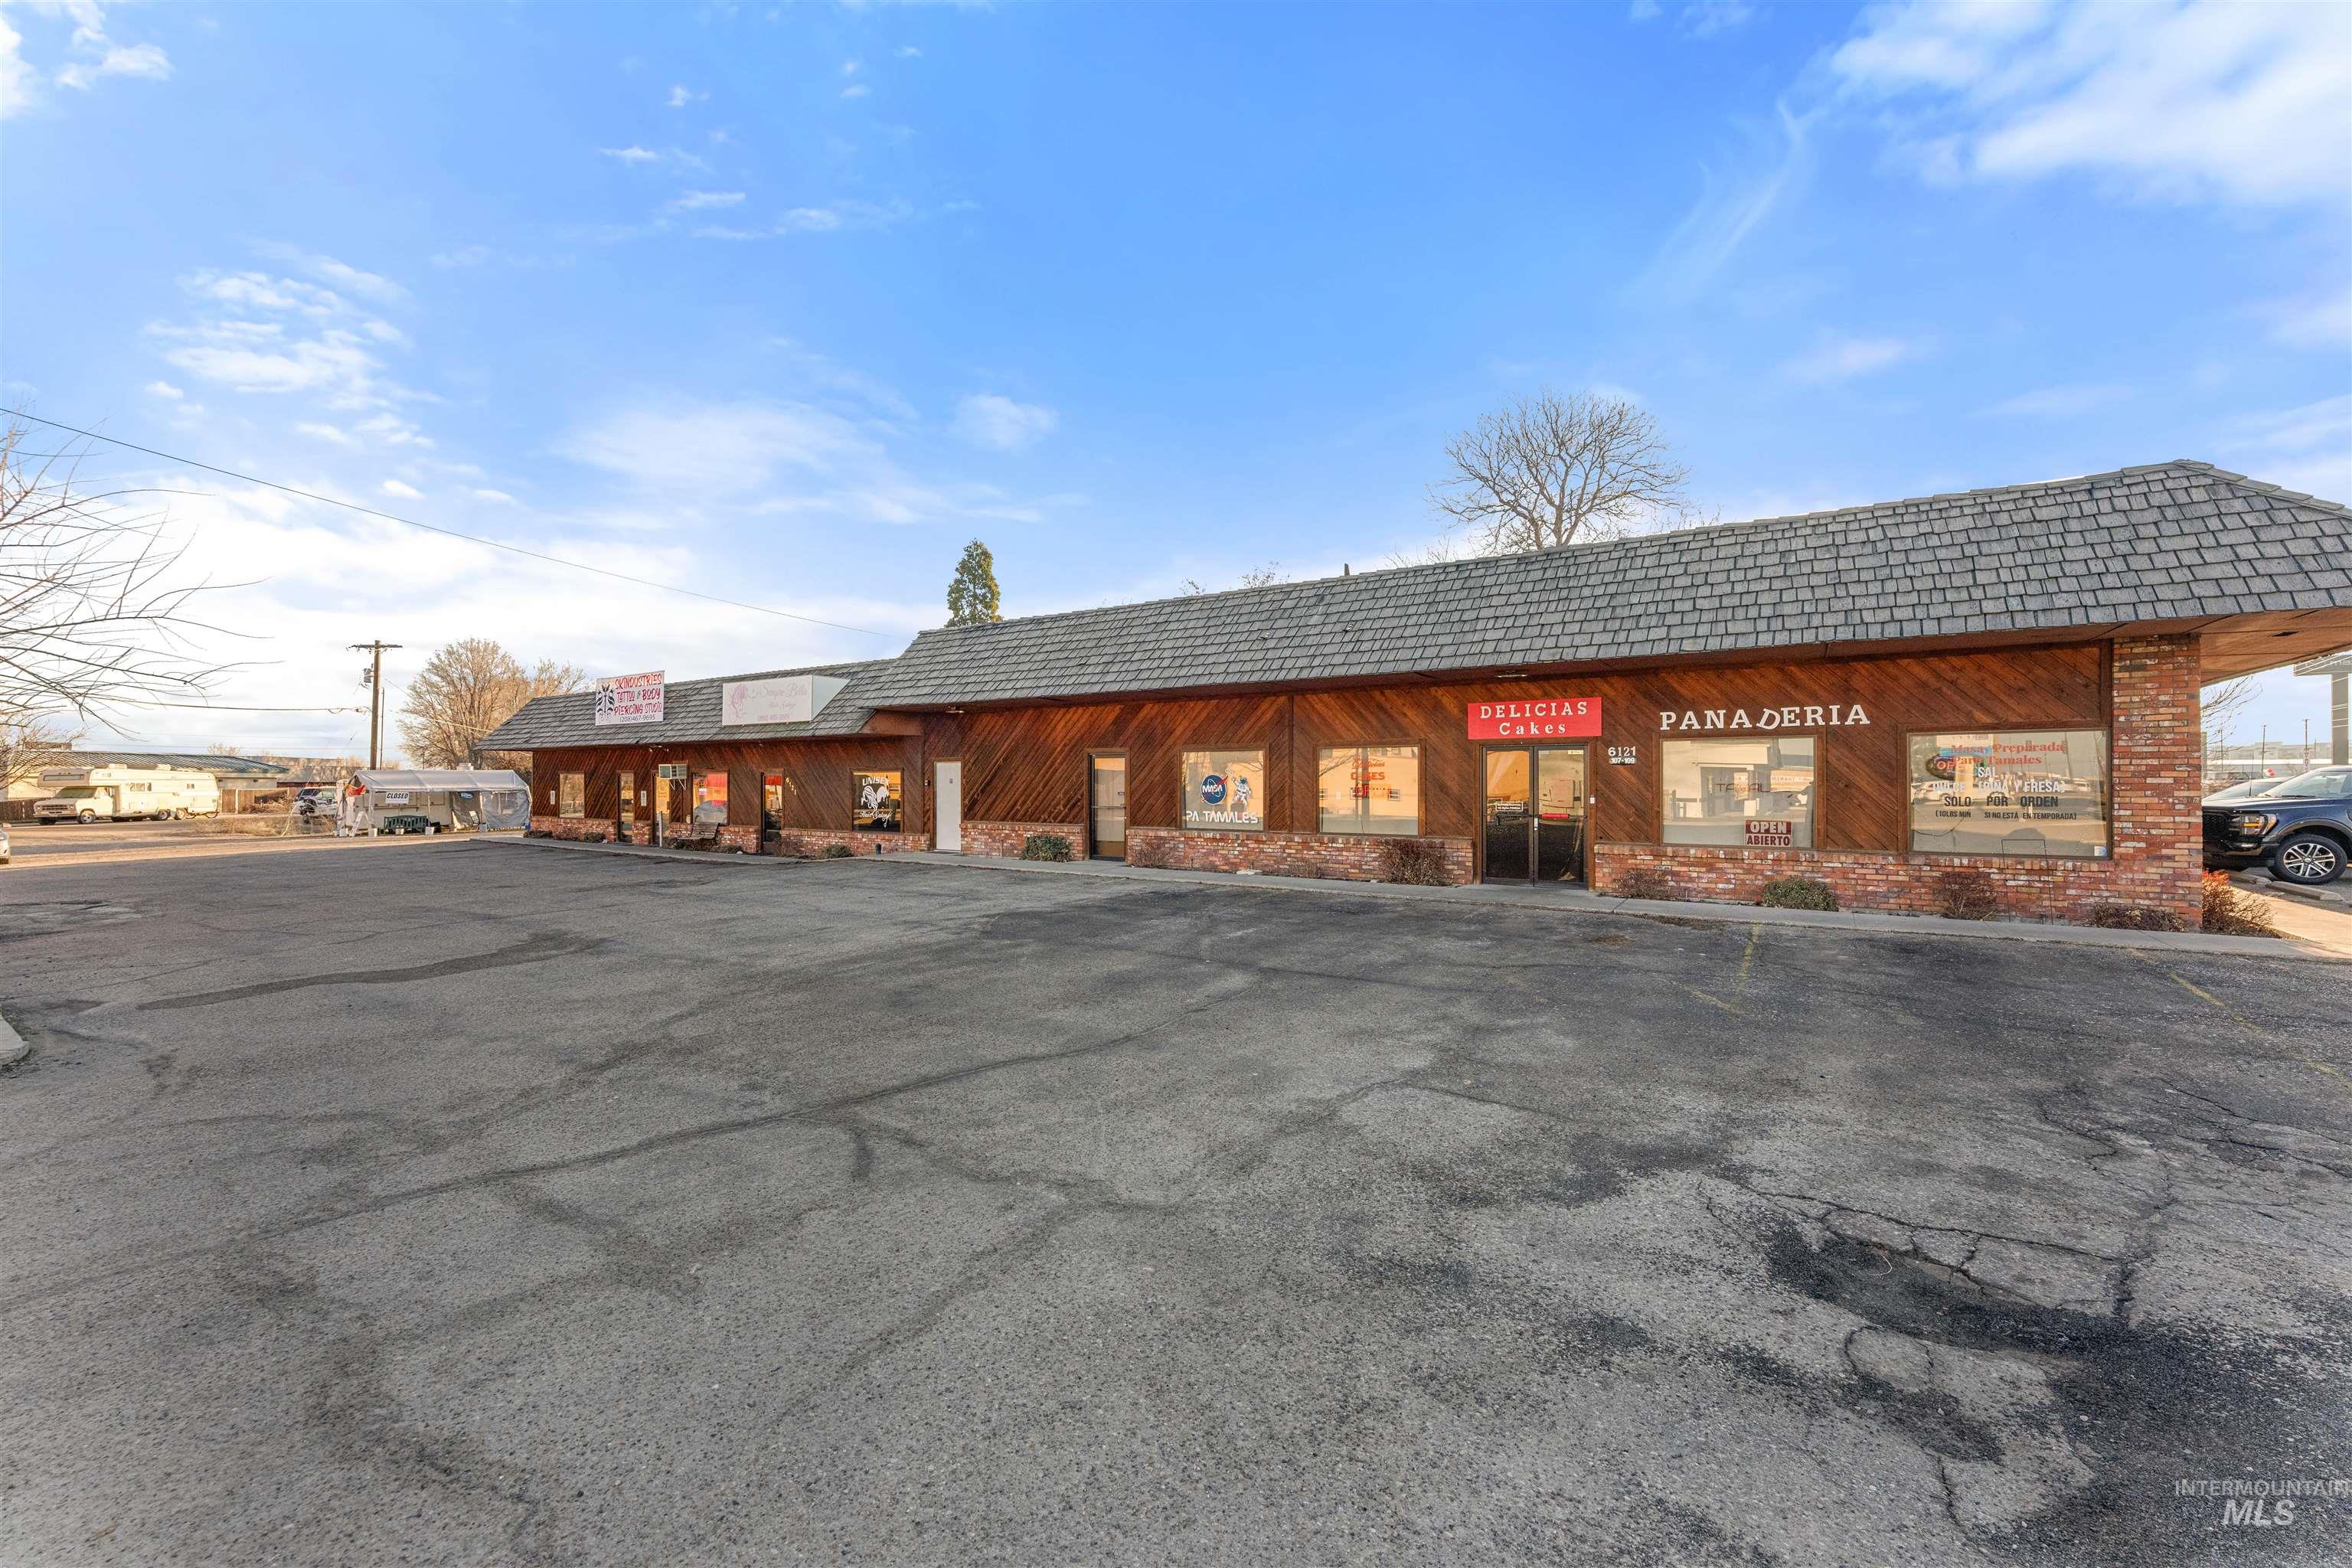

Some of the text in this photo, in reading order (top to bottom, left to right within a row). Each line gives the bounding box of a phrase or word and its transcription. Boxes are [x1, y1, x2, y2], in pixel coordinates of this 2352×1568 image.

[642, 688, 661, 701] BODY
[1480, 701, 1588, 719] DELICIAS
[1660, 704, 1870, 730] PANADERIA
[1499, 722, 1566, 735] Cakes
[1608, 746, 1637, 756] 6121
[1993, 741, 2064, 753] Preparada
[1988, 755, 2042, 765] Tamales
[1978, 766, 1998, 778] SAL
[1945, 796, 2059, 808] SOLO POR ORDEN
[1186, 811, 1200, 822] PA
[1750, 821, 1787, 834] OPEN
[1746, 834, 1791, 846] ABIERTO
